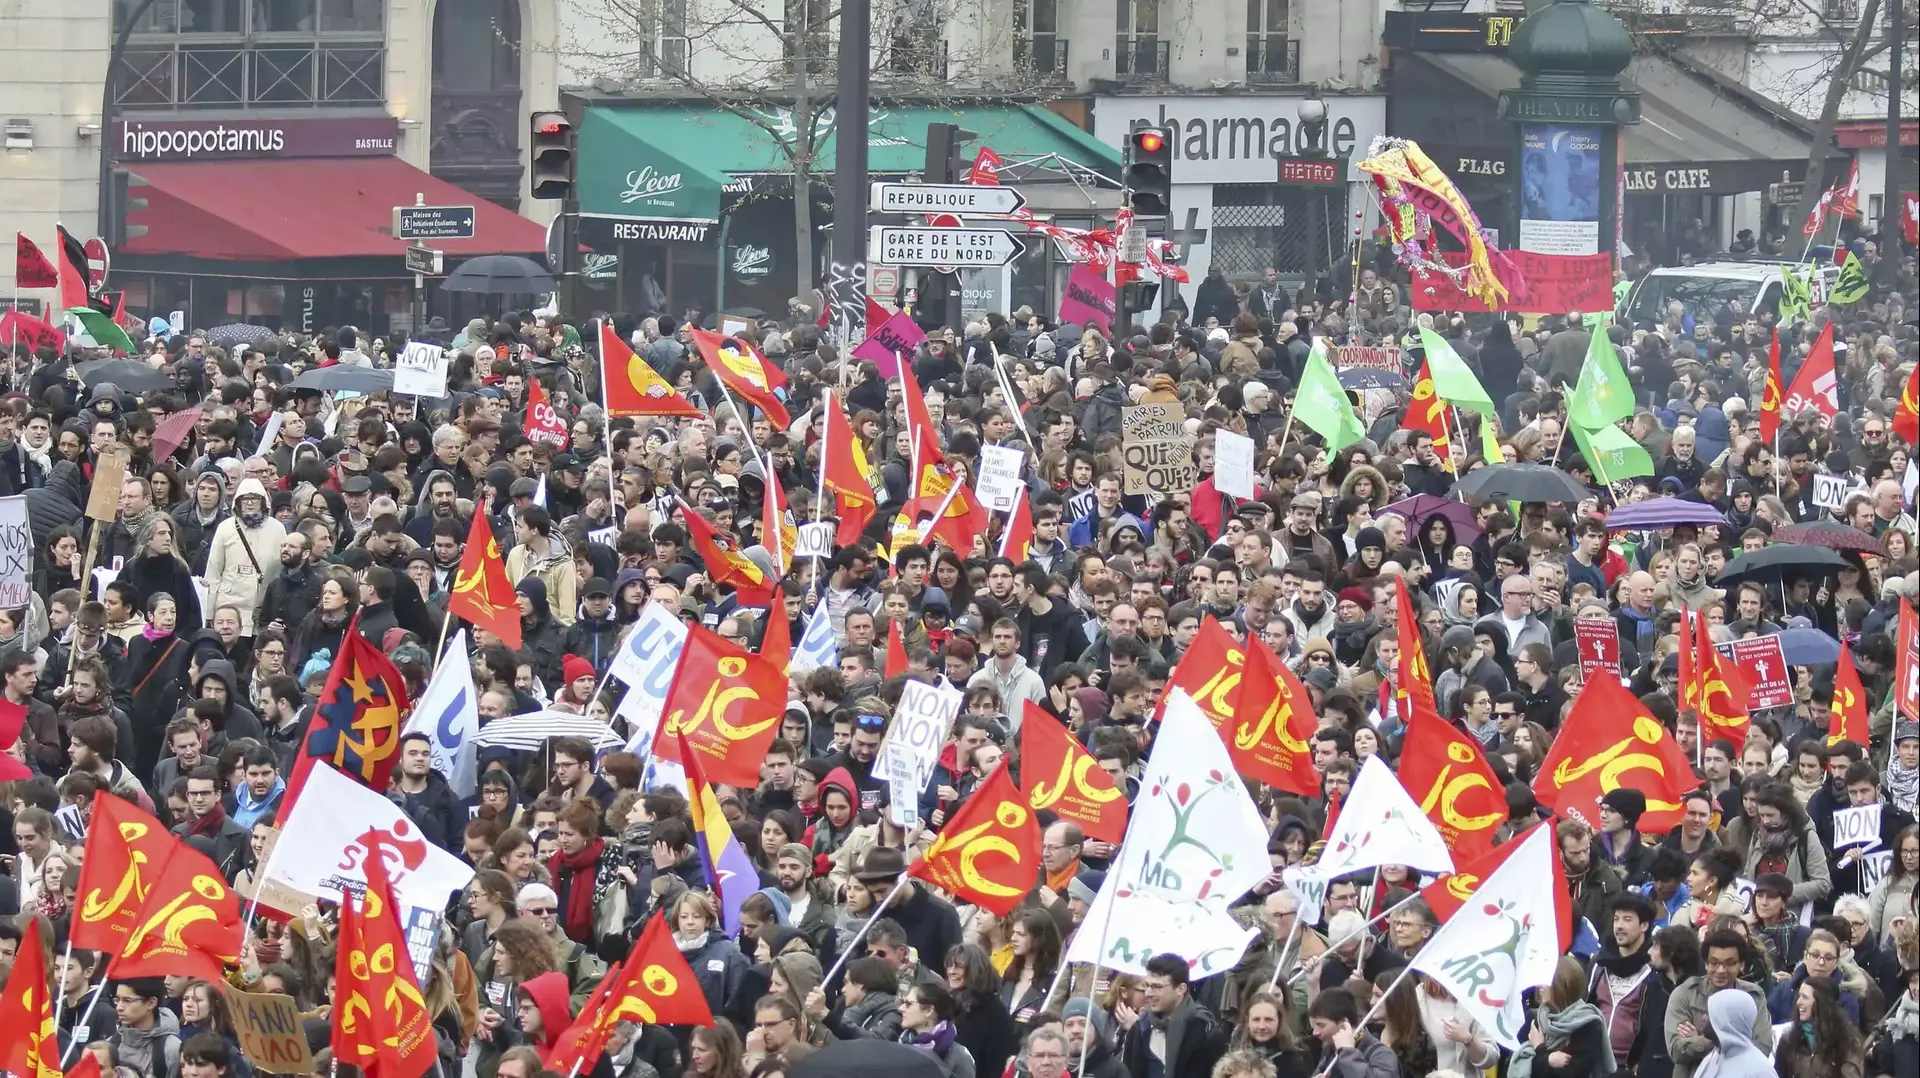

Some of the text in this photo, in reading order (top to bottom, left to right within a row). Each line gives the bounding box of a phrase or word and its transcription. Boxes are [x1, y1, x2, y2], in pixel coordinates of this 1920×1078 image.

[123, 121, 284, 157] hippopotamus
[1129, 103, 1355, 161] harmaie
[355, 138, 393, 149] BASTILLE
[1284, 161, 1335, 181] METRO
[1458, 158, 1506, 175] FLAG
[620, 165, 683, 203] Léon
[1624, 169, 1711, 190] LAG CAFE
[888, 193, 976, 206] REPUBLIQUE
[613, 223, 707, 242] RESTAURANT
[889, 234, 924, 245] GARE
[931, 234, 948, 246] DE
[888, 248, 993, 260] GARE DU NORD
[402, 346, 440, 371] NON
[1339, 347, 1387, 364] COORDINATION
[1787, 392, 1835, 430] atta
[1138, 421, 1185, 441] PATRONS
[1131, 477, 1145, 489] de
[1814, 479, 1845, 509] NON
[799, 526, 832, 553] NON
[1736, 639, 1763, 647] TRAVAILLER
[904, 686, 959, 725] NON
[698, 728, 730, 747] MOUVEMENT
[891, 714, 946, 751] NON
[688, 740, 726, 761] COMMUNISTES
[876, 754, 934, 788] NN
[1254, 753, 1293, 772] COMMUNISTES
[1063, 795, 1101, 809] MOUVEMENT
[1080, 806, 1101, 816] JEUNES
[1058, 806, 1101, 823] COMMUNISTES
[1834, 808, 1878, 843] NON
[319, 878, 367, 900] des Lcée
[330, 873, 367, 891] Syndica
[142, 945, 189, 959] COMMUNISTES
[230, 995, 296, 1034] MANU
[244, 1032, 301, 1064] CIAO
